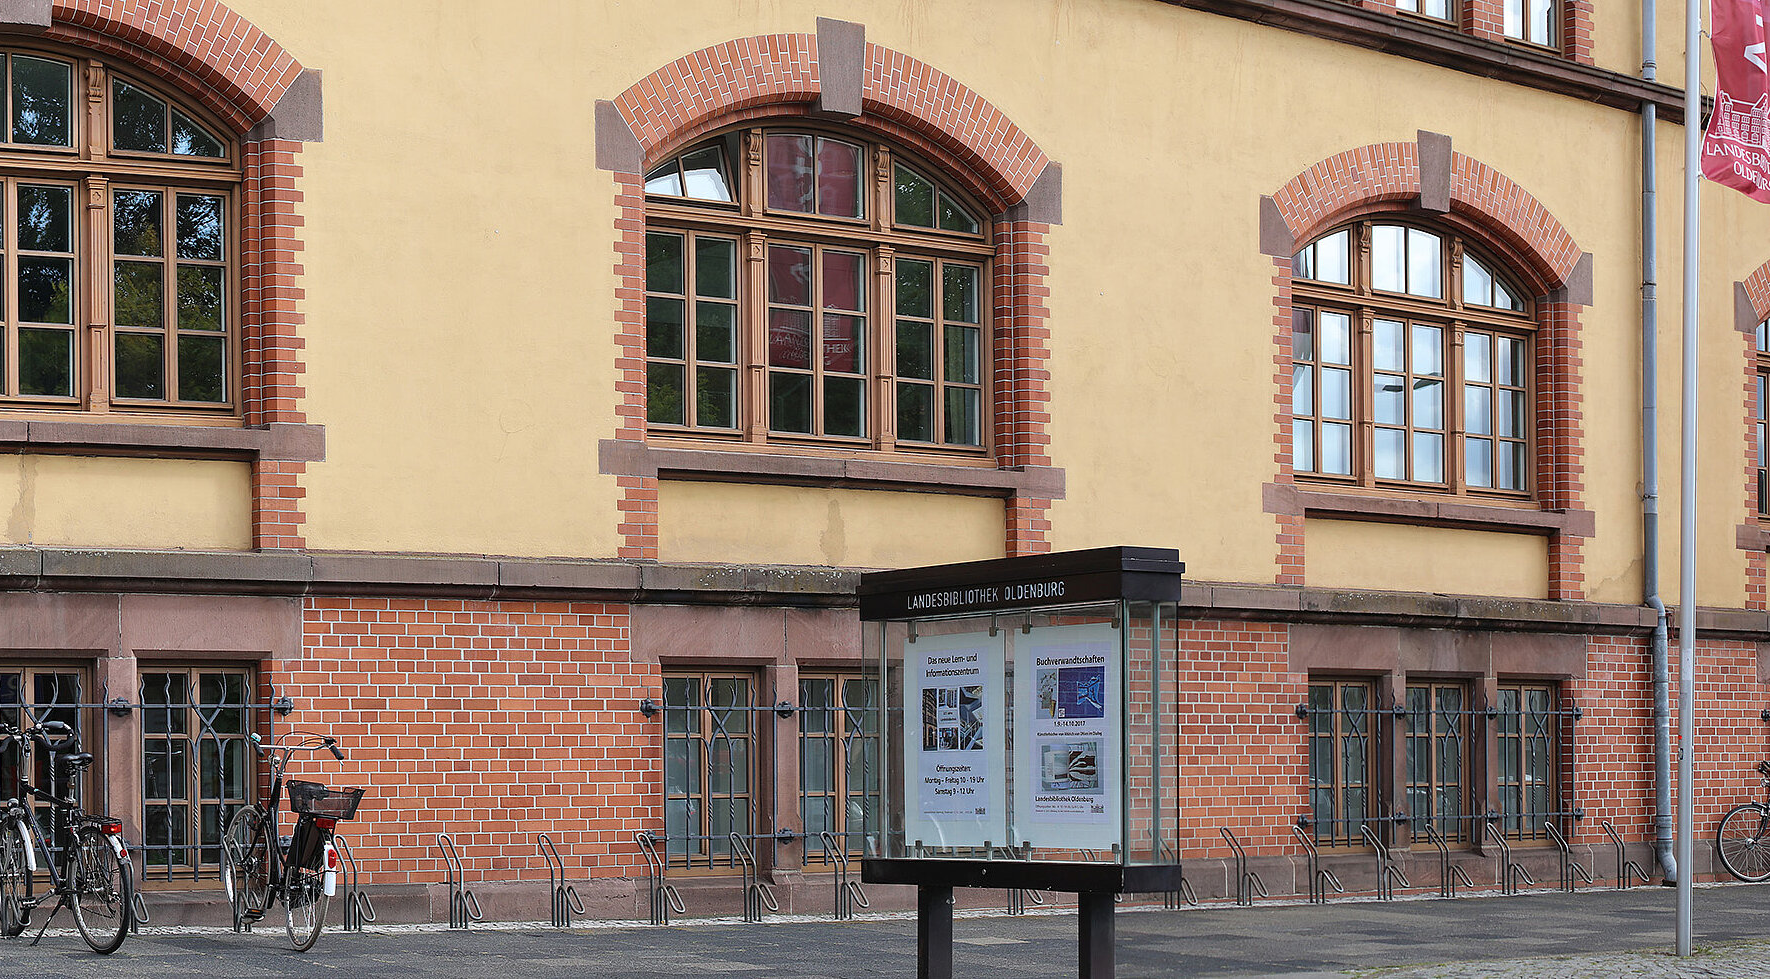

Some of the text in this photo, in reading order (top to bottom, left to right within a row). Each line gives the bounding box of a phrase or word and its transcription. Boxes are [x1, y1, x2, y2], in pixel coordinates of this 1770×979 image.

[907, 581, 1065, 610] LANDESBIBLIOTHEK OLDENBURG
[927, 656, 938, 665] Das
[938, 656, 950, 664] neue
[966, 652, 978, 662] und
[1036, 654, 1105, 666] Buchverwandtschaften
[925, 667, 980, 678] Informationszentrum
